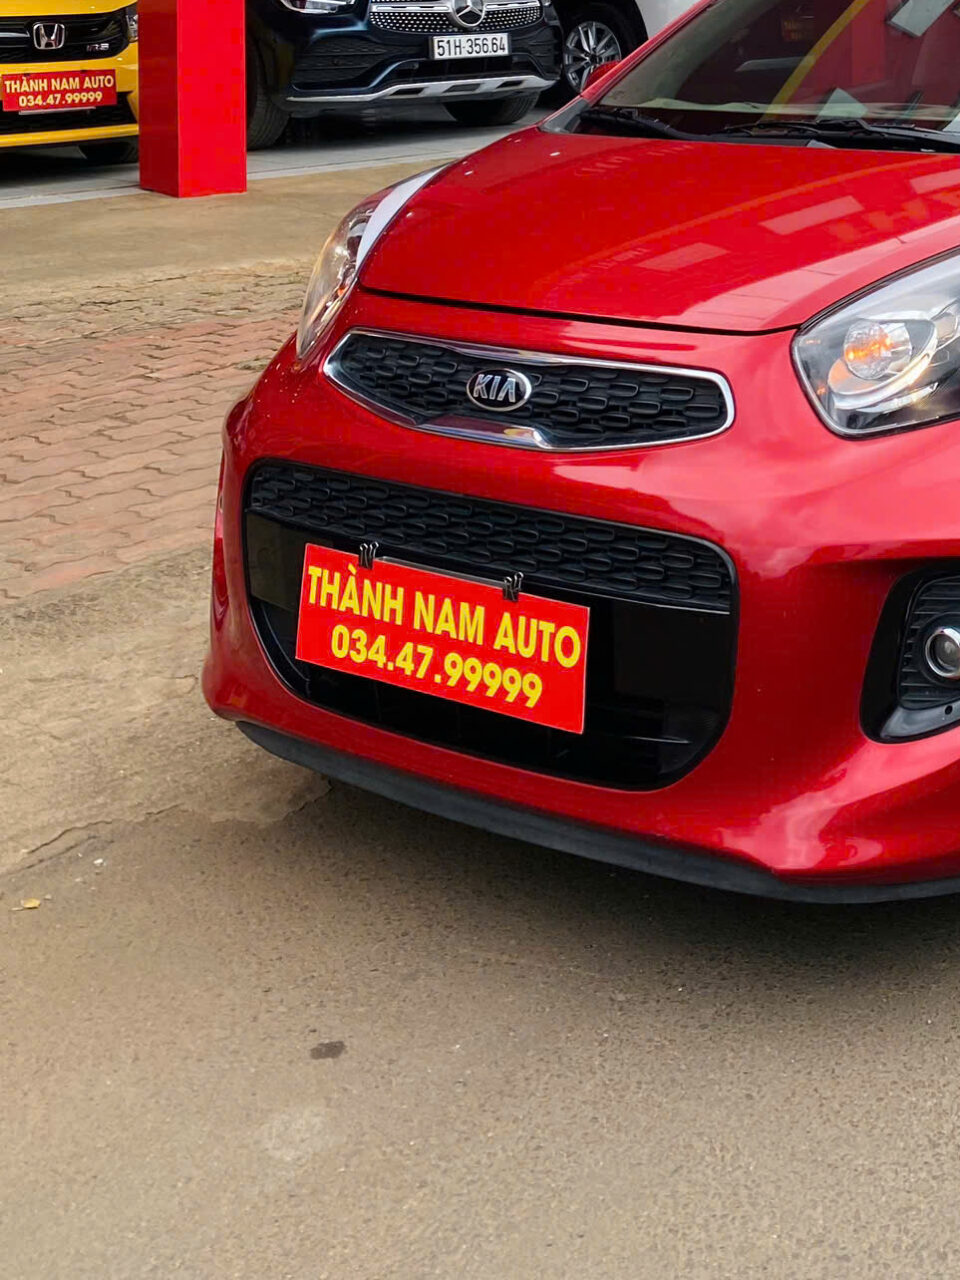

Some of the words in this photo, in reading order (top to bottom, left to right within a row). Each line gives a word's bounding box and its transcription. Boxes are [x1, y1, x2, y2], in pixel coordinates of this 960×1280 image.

[436, 37, 507, 58] 51H-356.64
[4, 75, 48, 94] THÀNH
[51, 78, 80, 91] NAM
[83, 74, 114, 89] AUTO
[18, 91, 104, 108] 034.47.99999
[472, 373, 517, 404] KIA
[307, 563, 405, 628] THÀNH
[413, 592, 485, 646] NAM
[493, 611, 581, 669] AUTO
[330, 624, 544, 710] 034.47.99999
